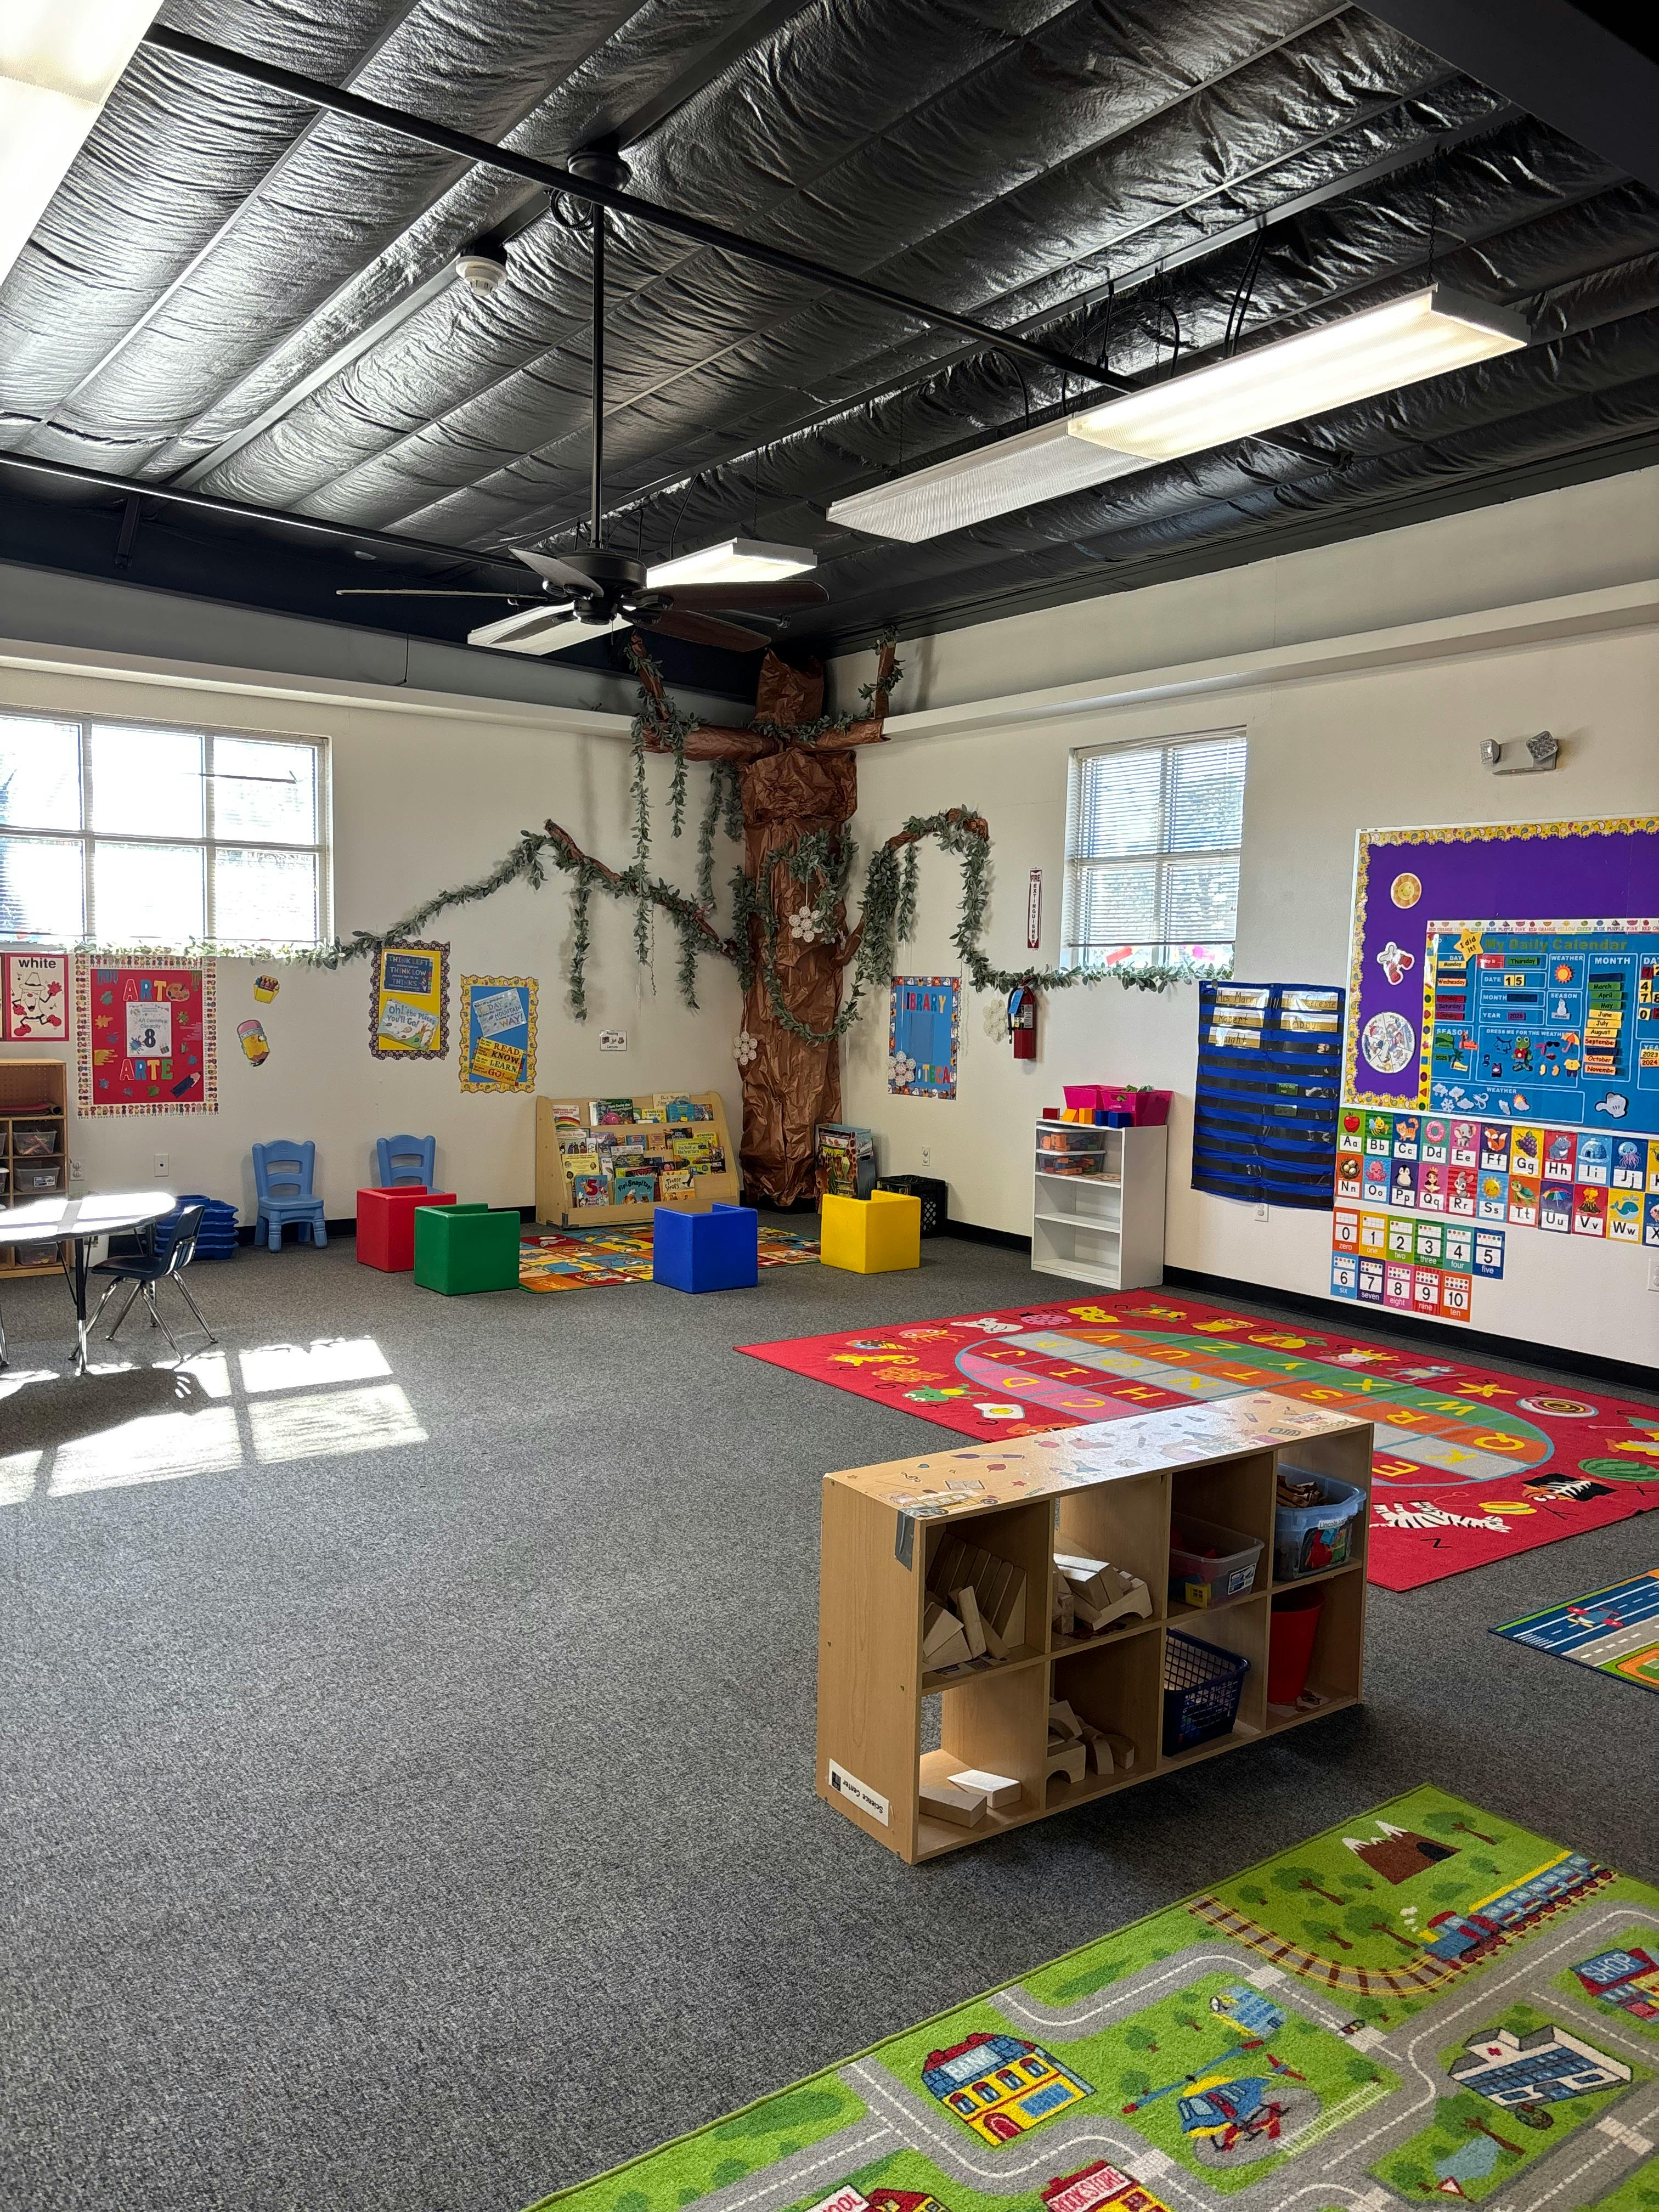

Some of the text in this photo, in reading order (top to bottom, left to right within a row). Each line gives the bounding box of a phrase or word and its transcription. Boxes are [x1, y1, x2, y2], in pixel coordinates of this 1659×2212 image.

[1031, 874, 1040, 883] FIRE
[1465, 936, 1476, 946] did
[1485, 938, 1628, 953] My Daily Calendar
[1468, 945, 1476, 953] it!
[18, 957, 57, 969] white
[388, 956, 411, 964] THINK
[392, 978, 417, 986] THINKS
[1641, 981, 1649, 991] 4
[123, 979, 167, 1001] ART
[900, 991, 946, 1014] LIBRARY
[1641, 994, 1649, 1003] 7
[389, 1004, 404, 1014] Oh!
[418, 1013, 436, 1025] Places
[494, 1005, 521, 1019] MOUNTAIN
[1218, 1011, 1249, 1025] Robert
[1640, 1010, 1647, 1019] 0
[387, 1015, 420, 1028] You'll Go!
[500, 1013, 523, 1028] WAY!
[144, 1028, 156, 1048] 8
[120, 1059, 173, 1081] ARTE
[585, 1179, 598, 1196] 5
[665, 1183, 680, 1192] SHOES
[1342, 1227, 1350, 1240] 0
[1371, 1231, 1375, 1245] 1
[1396, 1236, 1404, 1250] 2
[1425, 1240, 1433, 1254] 3
[1394, 1251, 1406, 1260] two
[1453, 1245, 1463, 1259] 4
[1483, 1249, 1493, 1264] 5
[1420, 1255, 1437, 1265] three
[1451, 1260, 1464, 1269] four
[1481, 1265, 1494, 1274] five
[1340, 1271, 1348, 1285] 6
[1367, 1276, 1375, 1290] 7
[1394, 1282, 1402, 1296] 8
[1422, 1286, 1430, 1301] 9
[1361, 1292, 1380, 1301] seven
[1390, 1297, 1406, 1307] eight
[1448, 1291, 1463, 1307] 10
[1418, 1302, 1433, 1312] nine
[1450, 1308, 1461, 1317] ten
[1111, 1386, 1167, 1400] H
[1386, 1410, 1430, 1425] R
[1473, 1432, 1526, 1451] Q
[1319, 1520, 1338, 1529] Lincoln
[842, 1779, 884, 1814] Science Center
[1581, 1953, 1635, 1982] SHOP
[944, 2047, 992, 2078] BANK
[1049, 2168, 1126, 2212] BOOKSTORE
